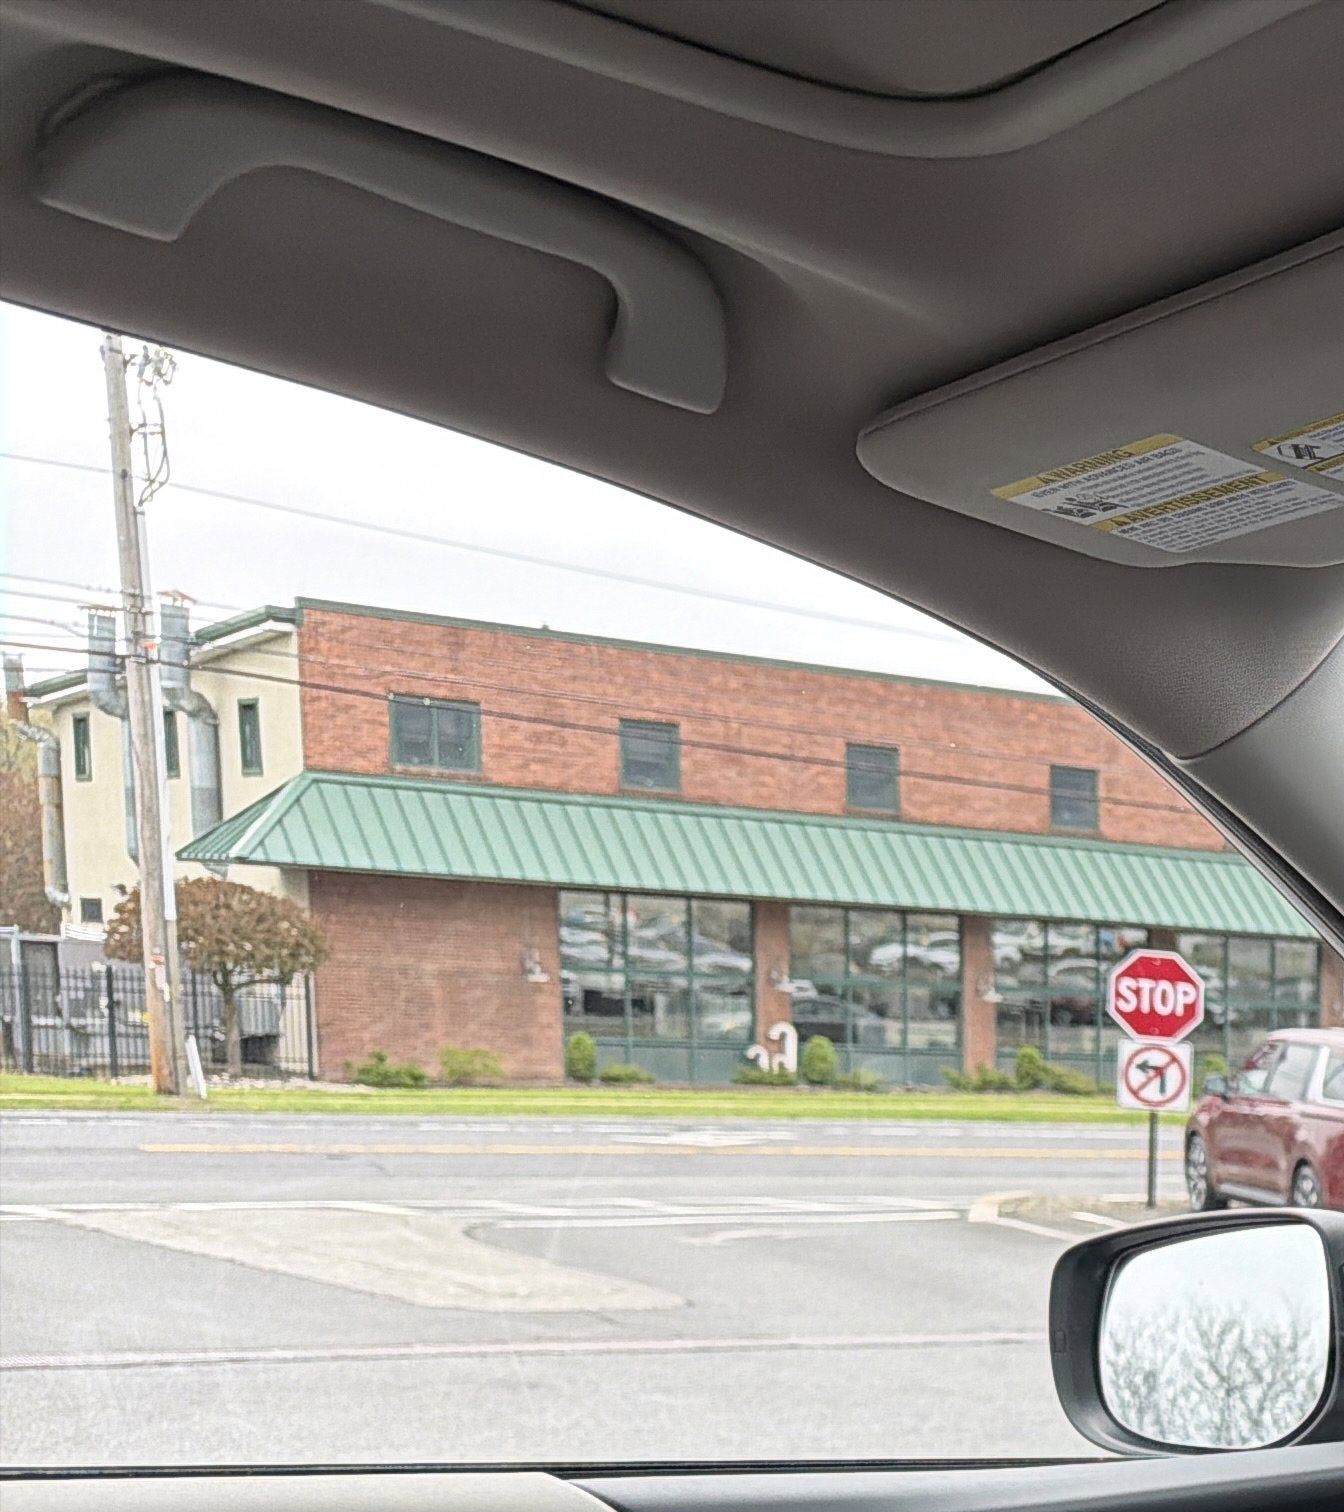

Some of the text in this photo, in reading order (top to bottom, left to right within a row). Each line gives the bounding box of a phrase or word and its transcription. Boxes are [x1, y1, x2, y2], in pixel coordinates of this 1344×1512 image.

[1053, 449, 1136, 480] WARNING
[1126, 475, 1269, 523] AVERTISSEMENT
[1116, 976, 1197, 1017] STOP
